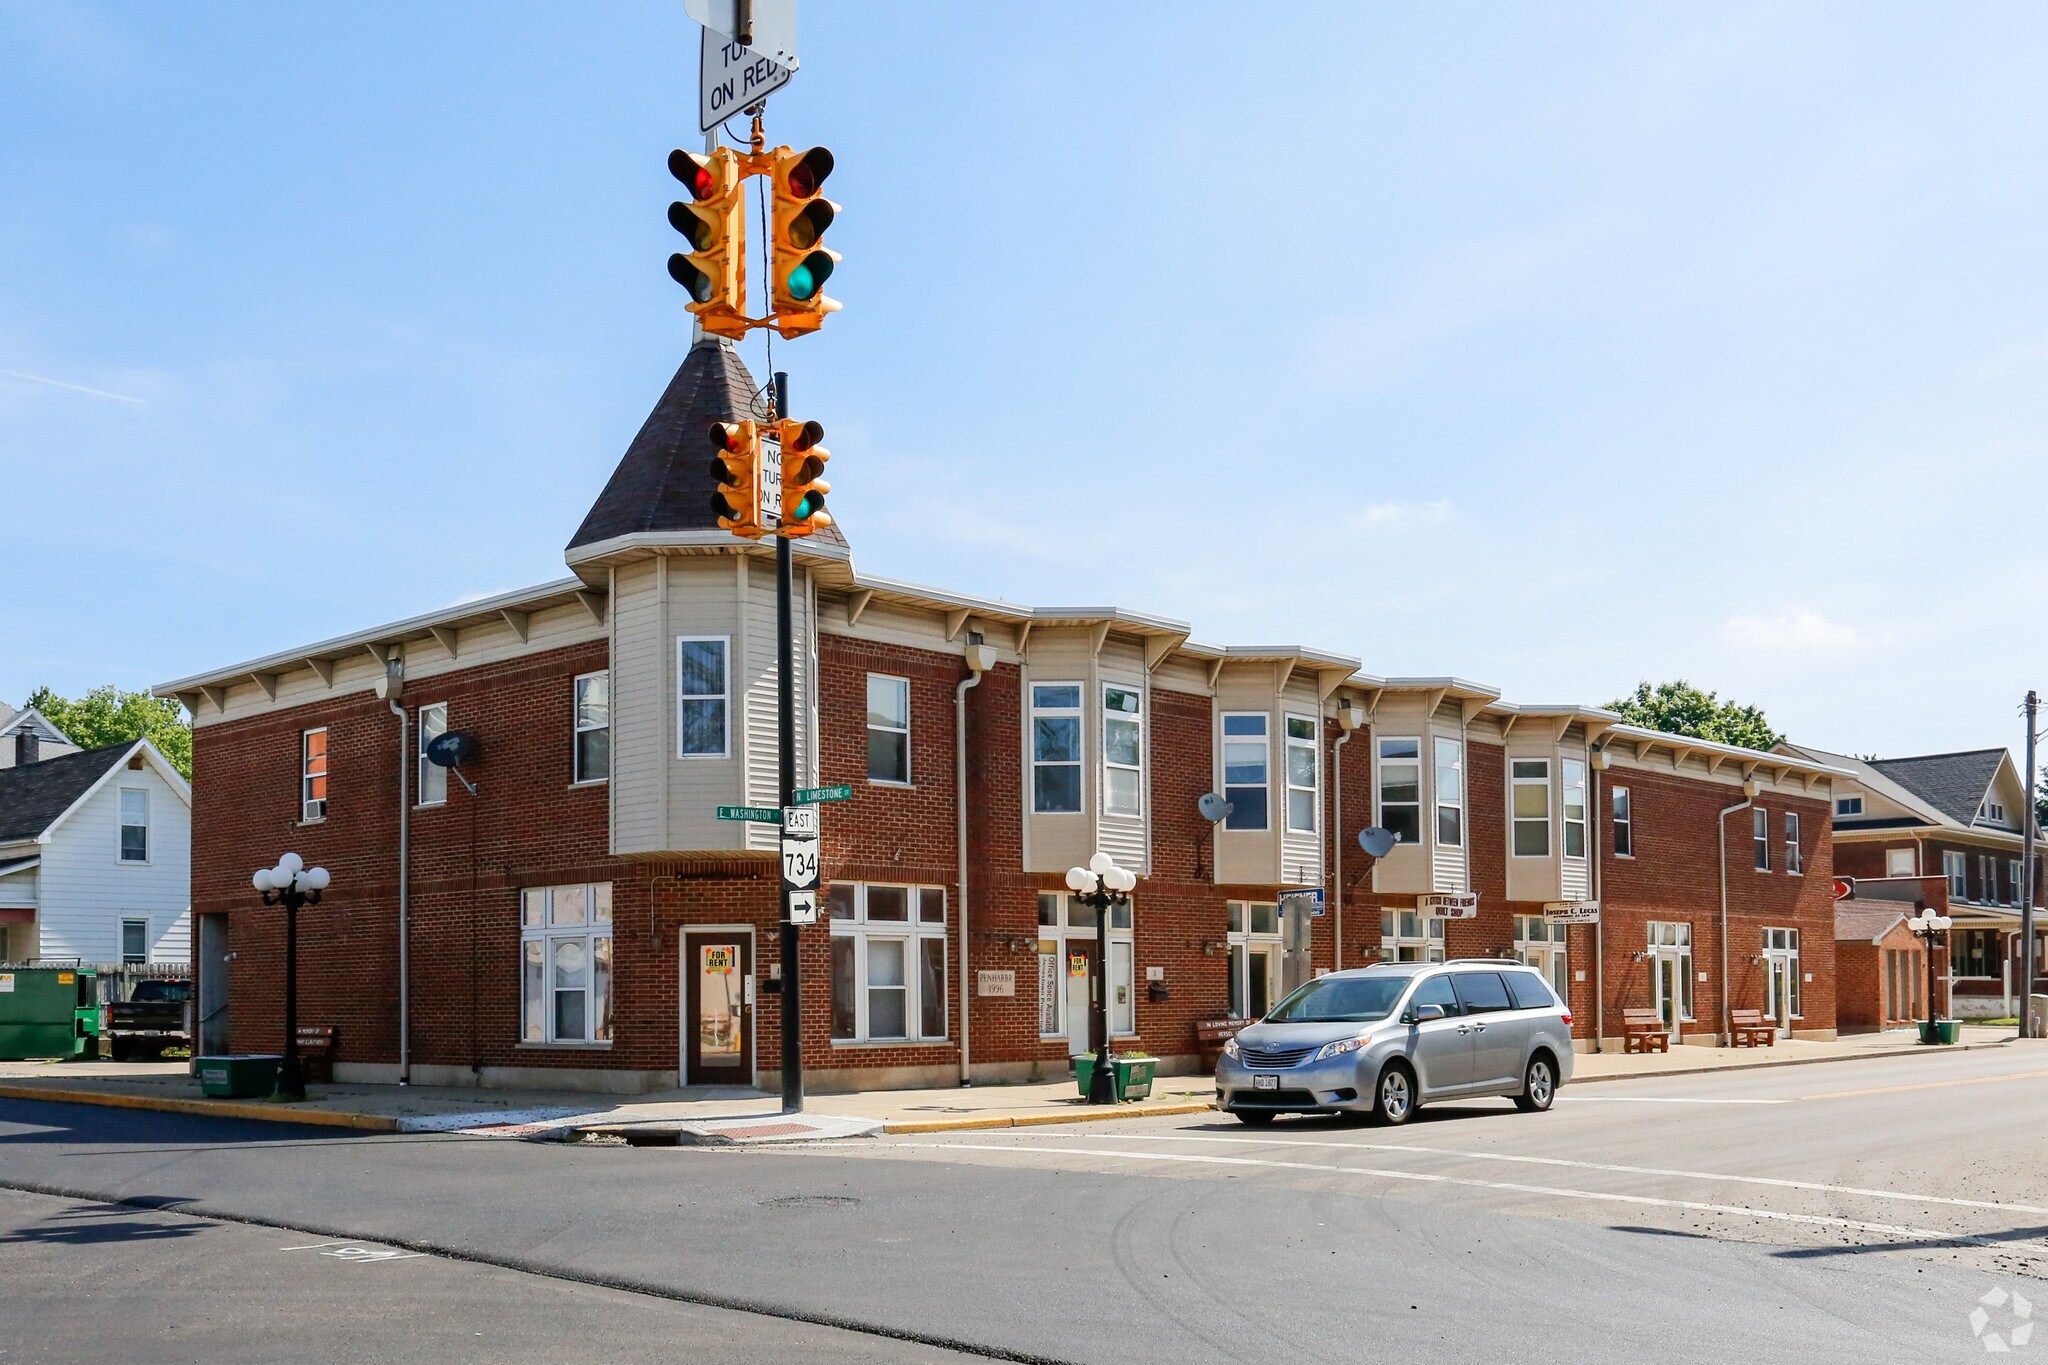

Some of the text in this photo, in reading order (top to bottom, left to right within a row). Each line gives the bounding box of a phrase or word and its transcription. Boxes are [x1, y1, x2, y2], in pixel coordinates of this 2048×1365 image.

[711, 57, 778, 110] ON RED
[807, 788, 843, 801] LIMESTONE
[730, 808, 772, 820] WASHINGTON
[788, 811, 809, 828] EAST
[785, 853, 816, 876] 734
[712, 951, 725, 959] FOR
[709, 959, 728, 967] RENT
[1047, 956, 1055, 979] Office
[988, 984, 1004, 993] 1996
[1046, 980, 1054, 1002] Space
